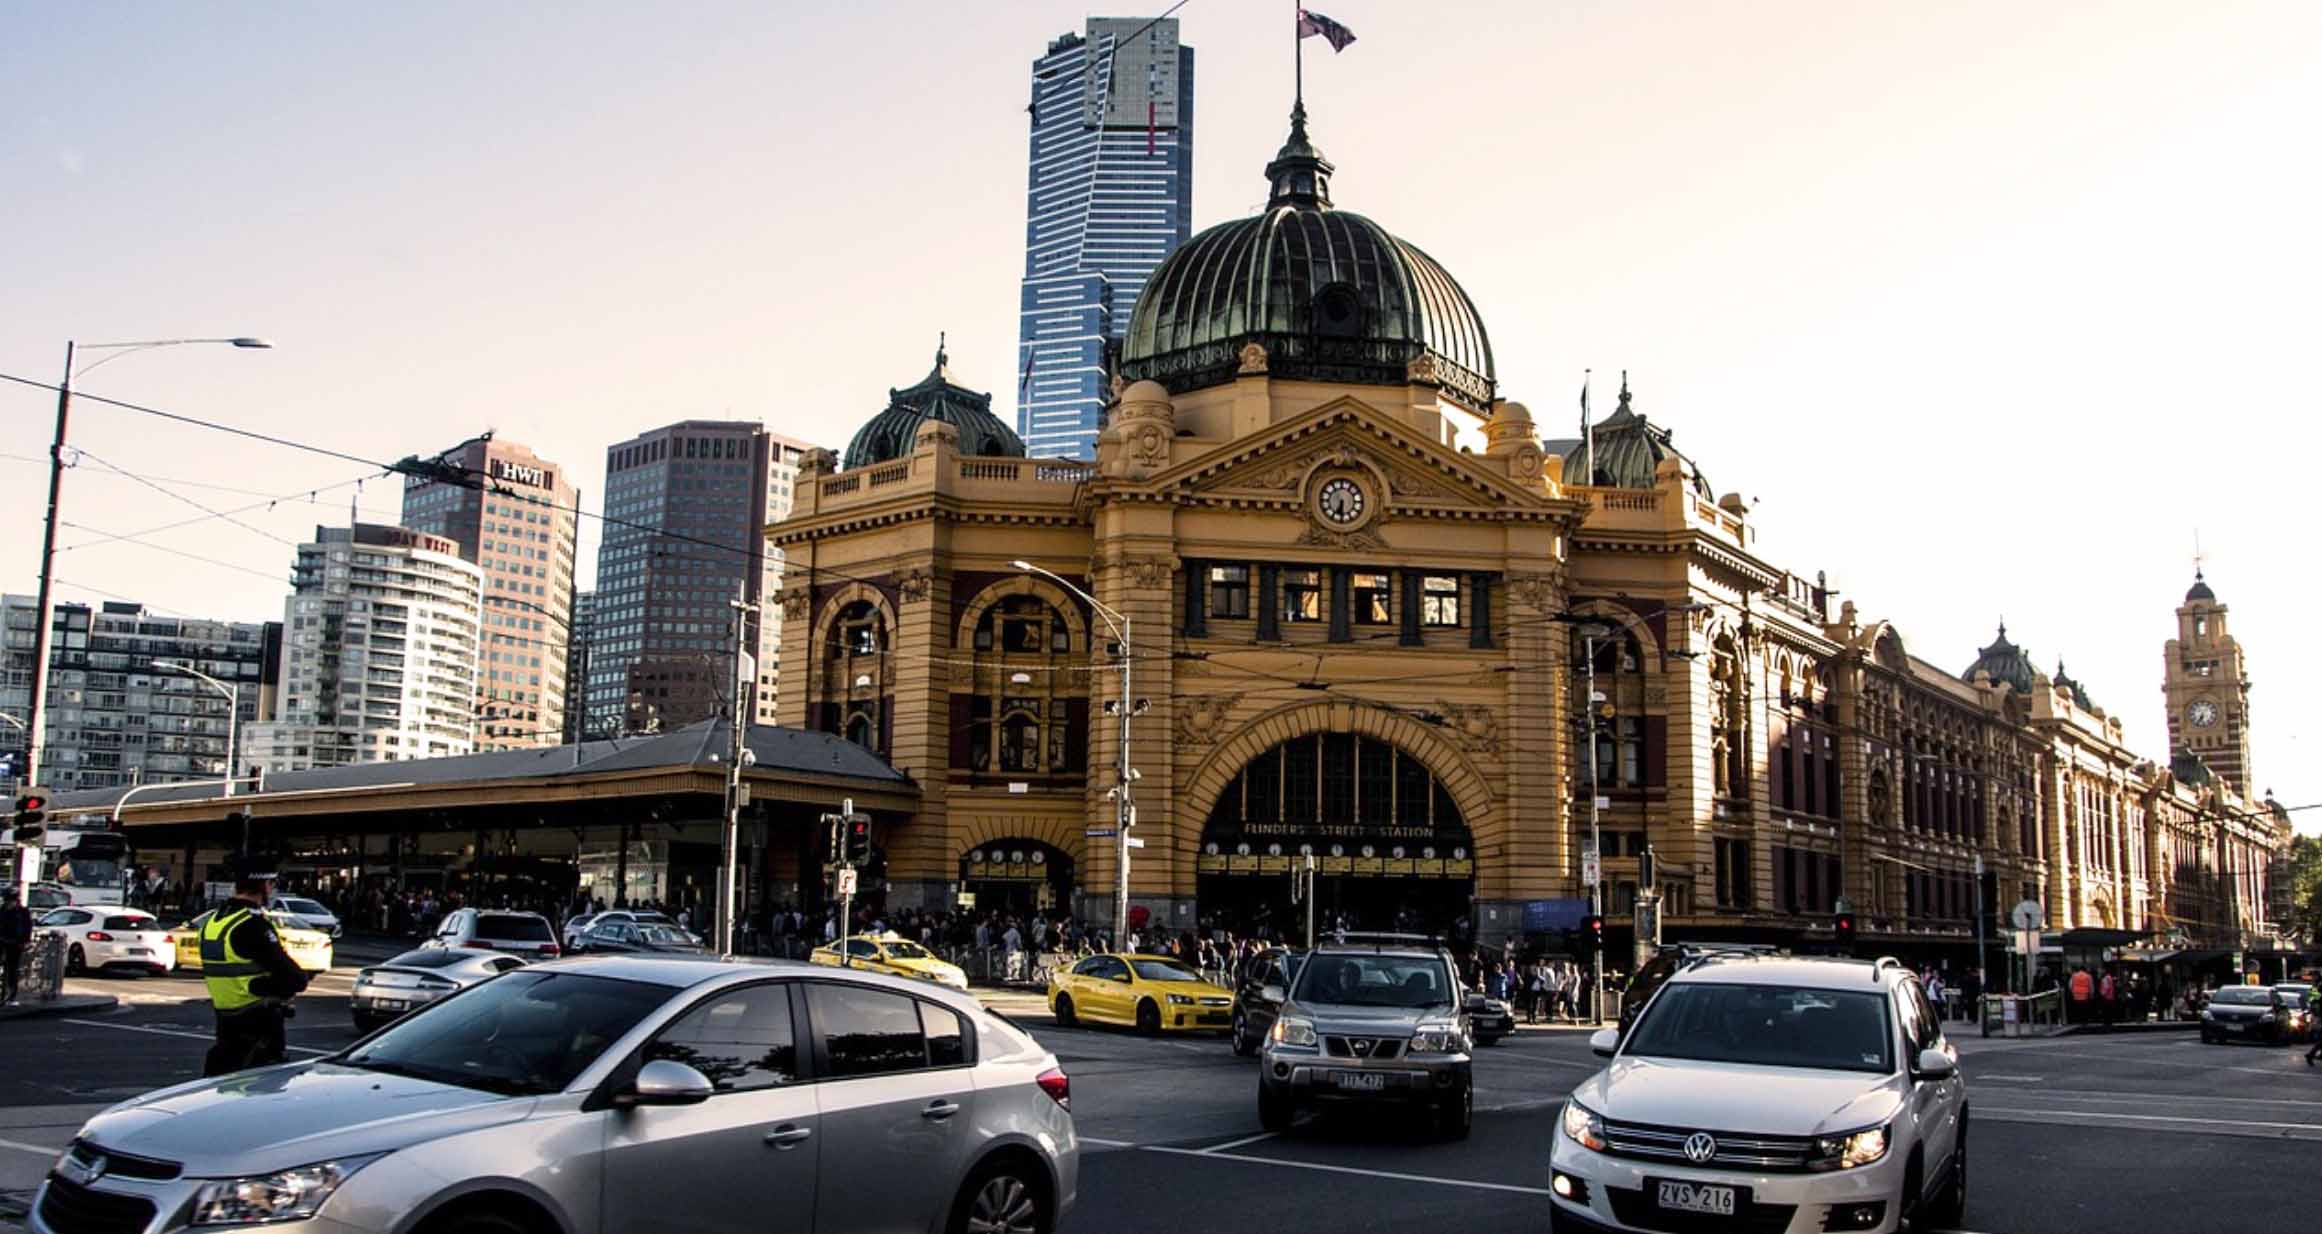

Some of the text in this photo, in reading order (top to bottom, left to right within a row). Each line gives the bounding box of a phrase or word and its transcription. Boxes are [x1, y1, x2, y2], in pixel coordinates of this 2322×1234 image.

[503, 463, 541, 485] HWT
[425, 535, 451, 555] WEST
[1244, 823, 1434, 838] FLINDERS STREET STATION
[1660, 1183, 1690, 1204] ZVS
[1702, 1188, 1731, 1209] 216
